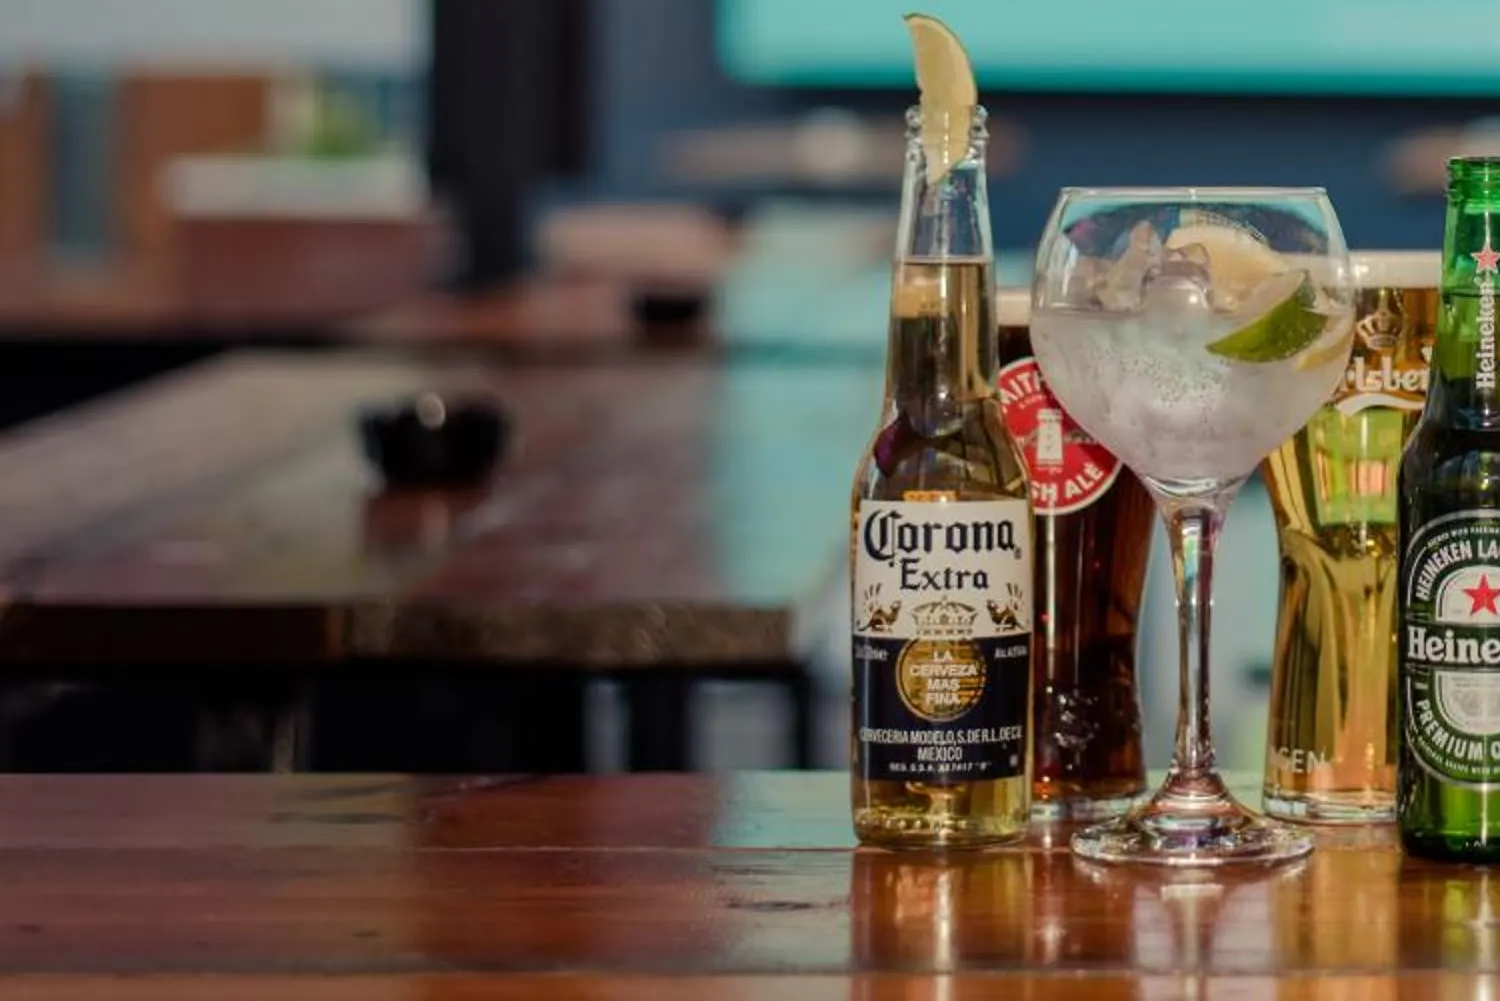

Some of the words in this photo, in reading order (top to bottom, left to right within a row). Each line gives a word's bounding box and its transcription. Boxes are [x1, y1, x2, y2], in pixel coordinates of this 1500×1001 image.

[1475, 279, 1496, 391] Heineken
[1064, 461, 1104, 499] ALE
[864, 509, 1016, 562] Corona
[900, 558, 990, 590] Extra
[1415, 540, 1473, 602] HEINEKEN
[909, 663, 978, 676] CERVEZA
[932, 650, 953, 662] LA
[926, 692, 960, 704] FINA
[1415, 699, 1483, 761] PREMIUM
